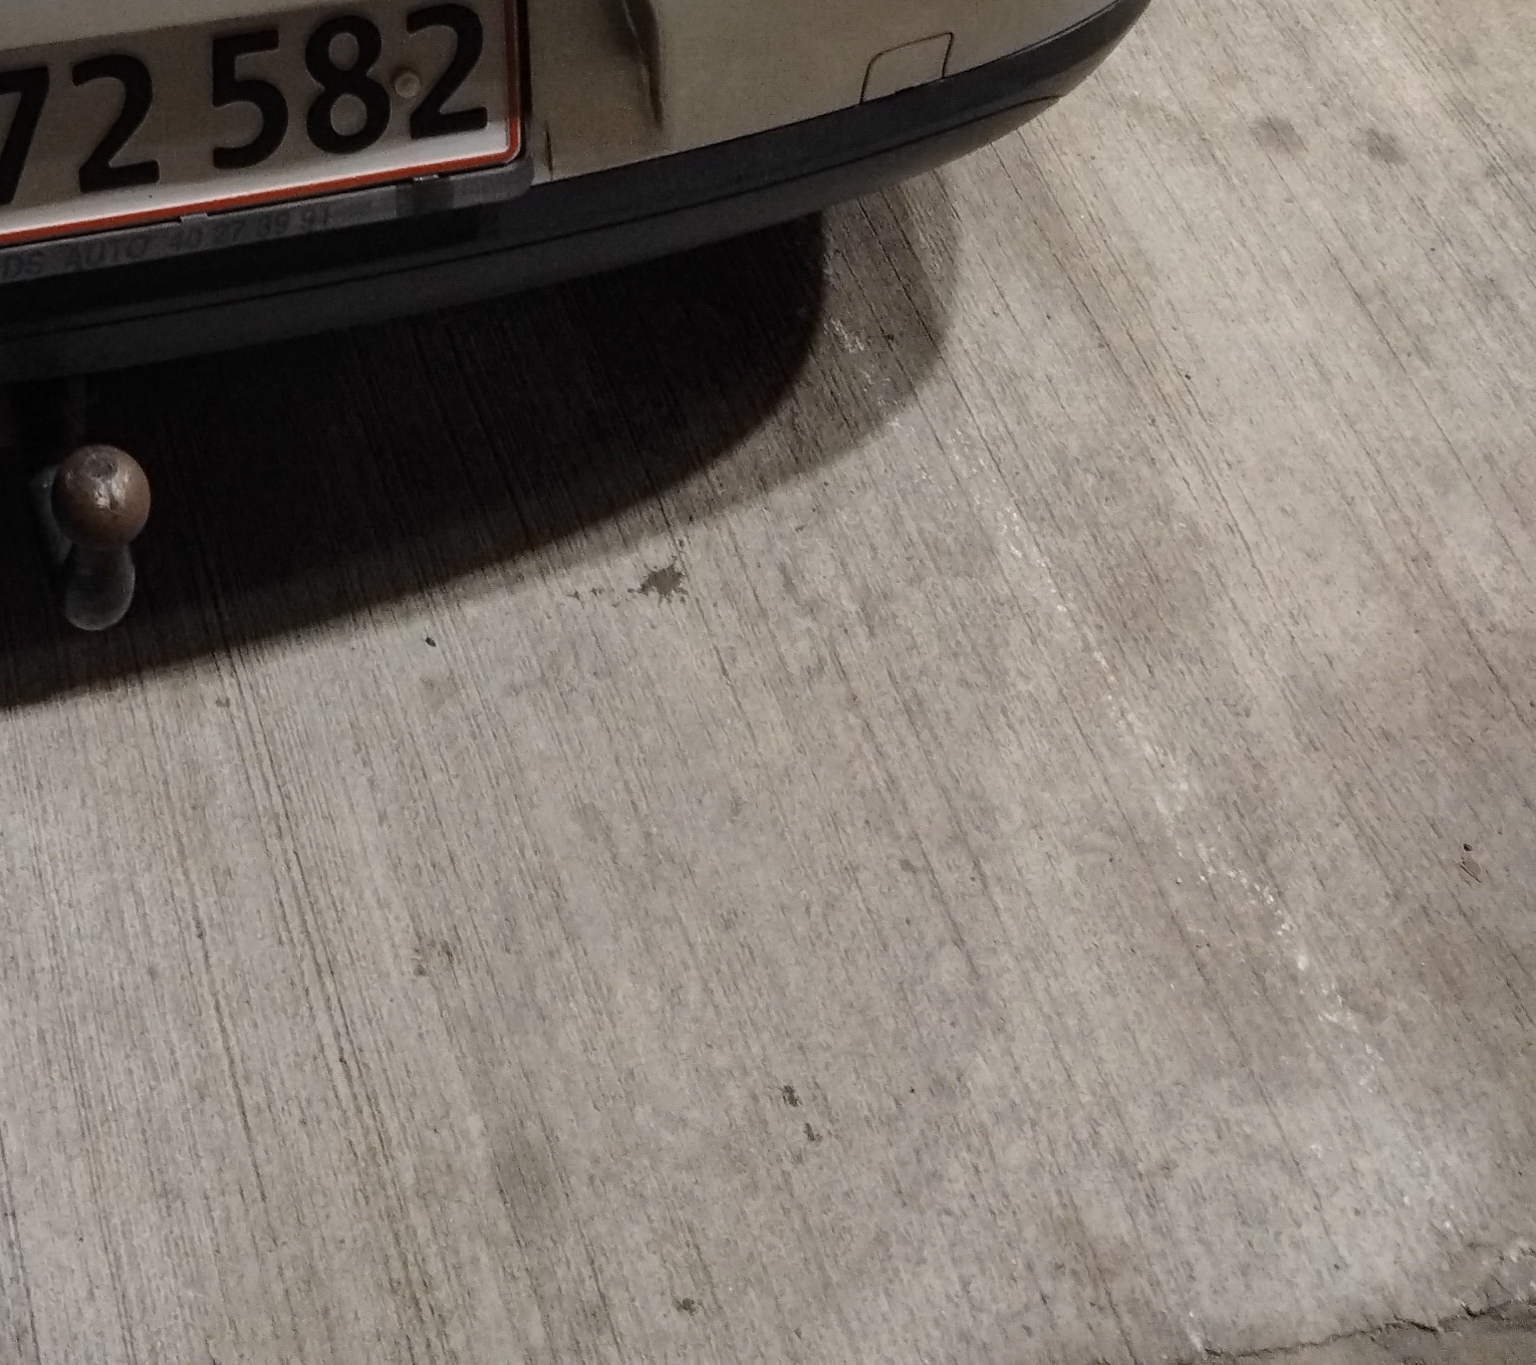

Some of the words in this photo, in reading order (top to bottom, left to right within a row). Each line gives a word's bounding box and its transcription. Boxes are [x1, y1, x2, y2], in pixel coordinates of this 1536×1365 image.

[212, 3, 488, 169] 582
[65, 233, 150, 272] AUTO
[173, 224, 206, 252] 40
[260, 212, 290, 239] 39
